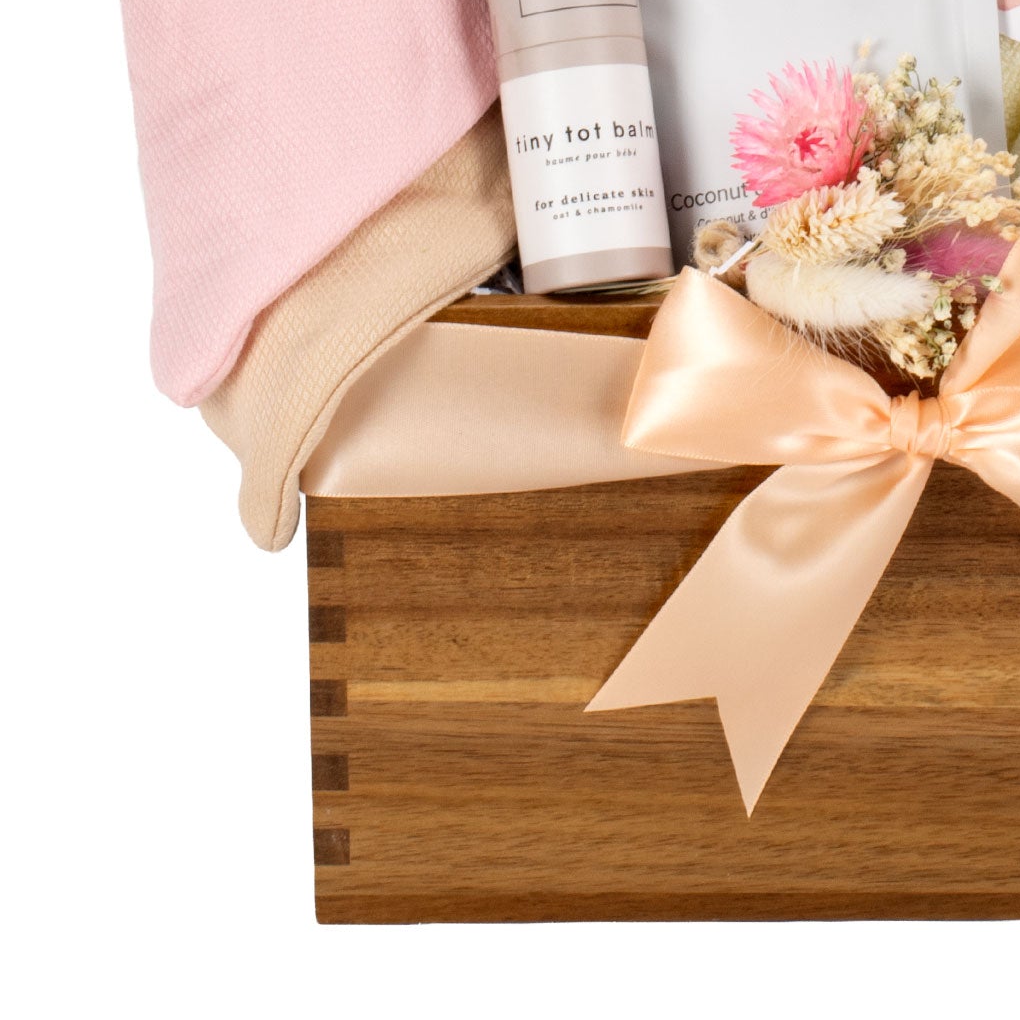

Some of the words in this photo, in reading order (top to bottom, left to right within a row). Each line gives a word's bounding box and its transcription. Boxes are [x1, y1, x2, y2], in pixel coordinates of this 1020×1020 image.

[516, 133, 554, 154] tiny
[565, 122, 602, 143] tot
[613, 120, 654, 139] balm
[545, 154, 581, 167] baume
[585, 150, 612, 163] pour
[616, 148, 638, 158] bébé
[535, 198, 554, 212] for
[561, 190, 625, 206] delicate
[631, 187, 655, 198] skin
[670, 182, 749, 211] Coconut
[552, 210, 570, 221] oat
[575, 209, 582, 217] &
[587, 203, 644, 216] chamomile
[748, 210, 757, 221] &
